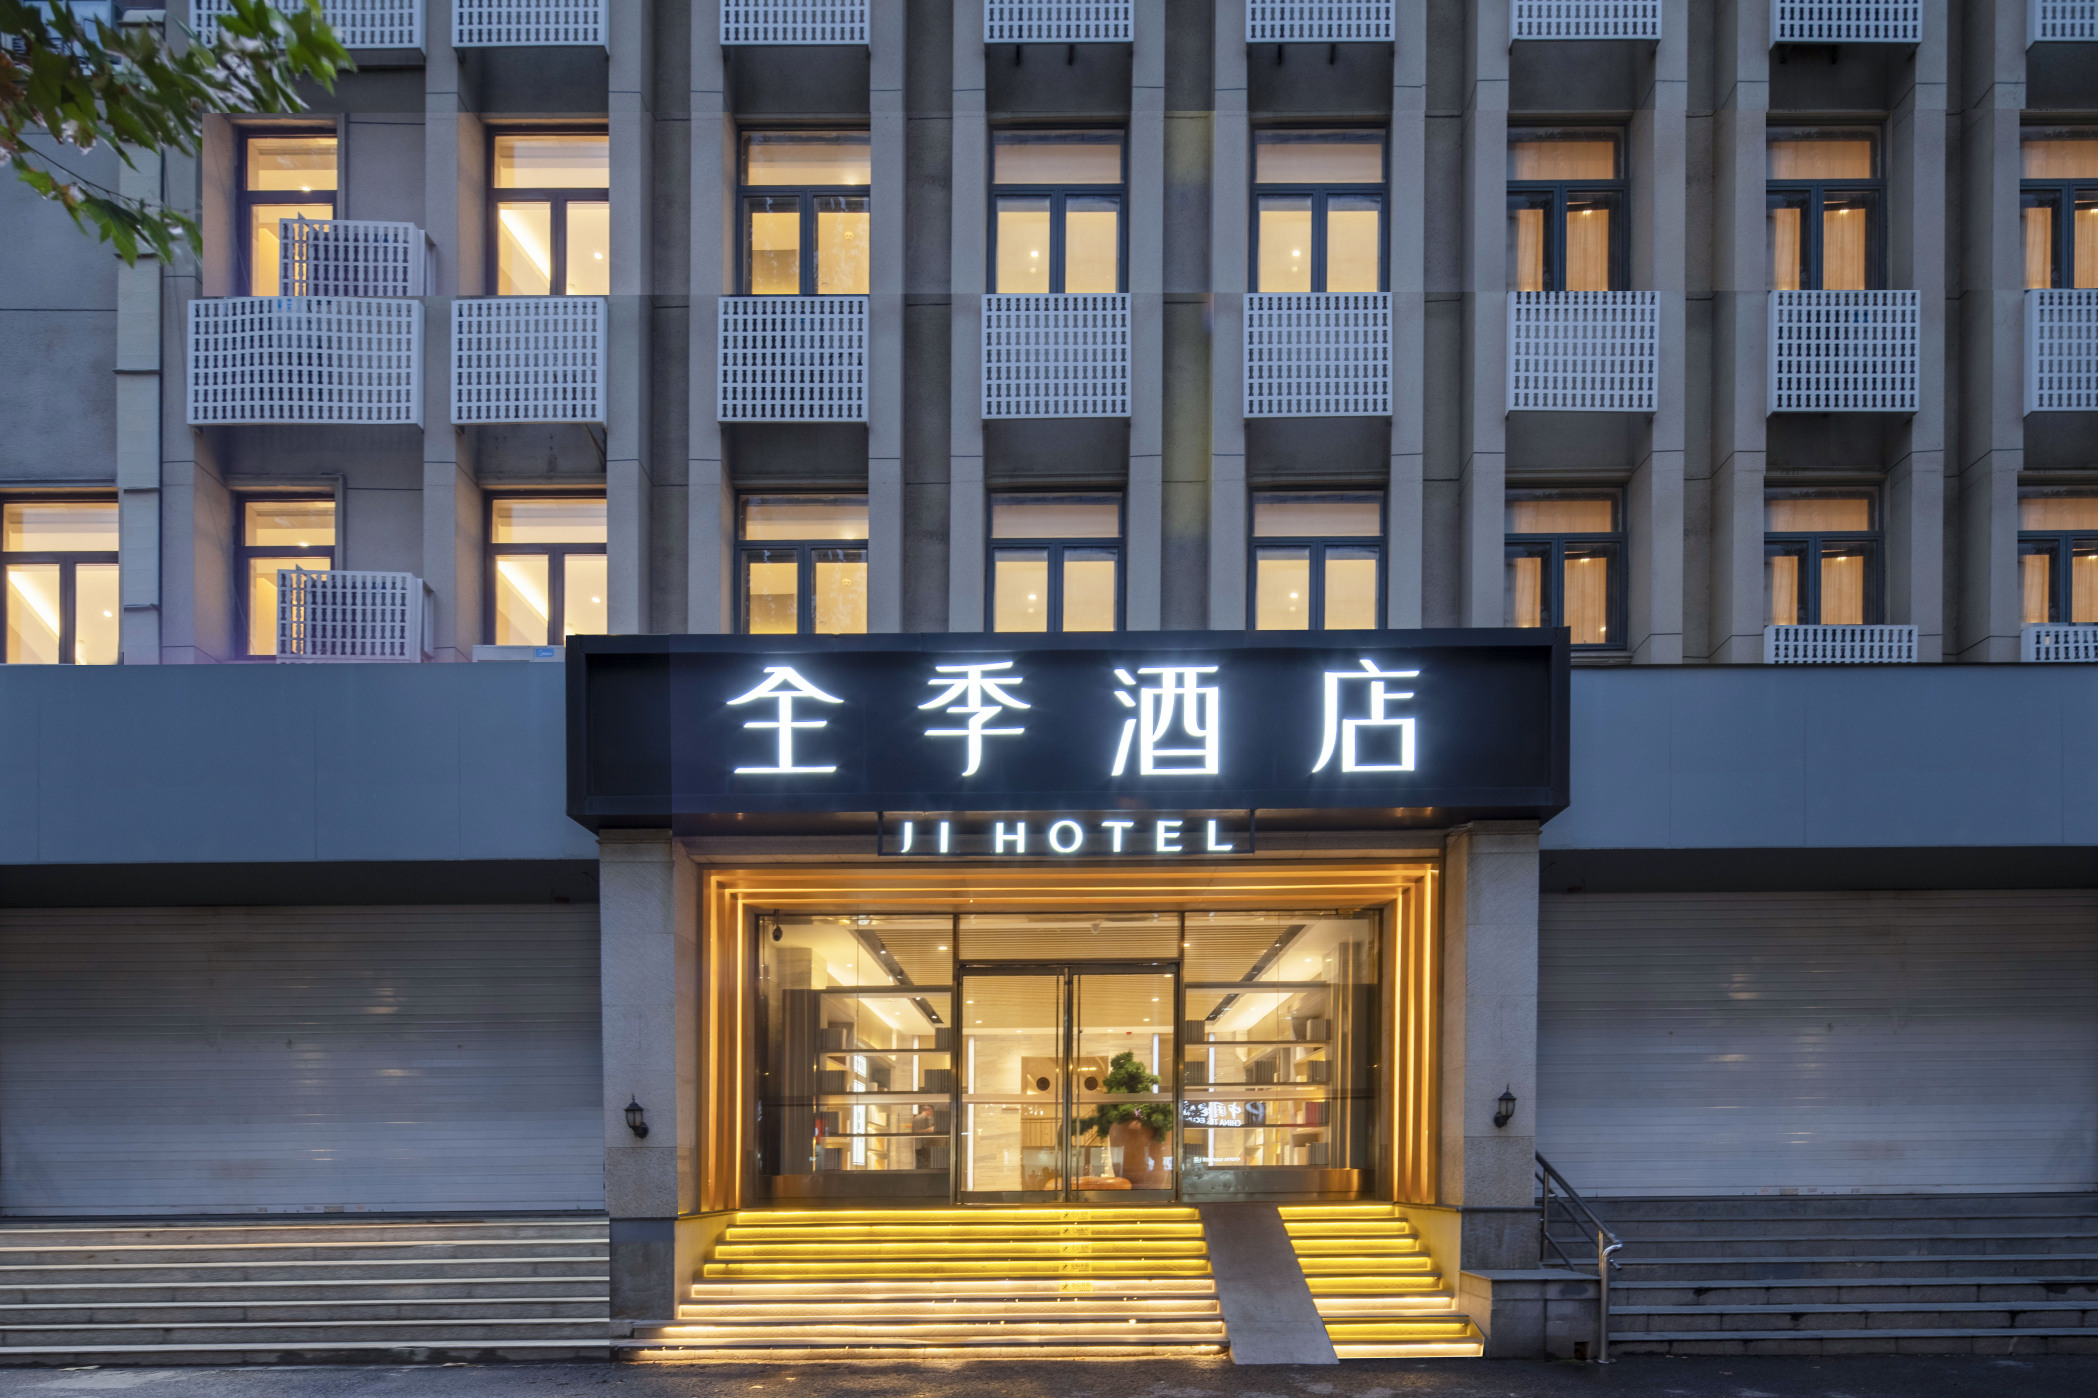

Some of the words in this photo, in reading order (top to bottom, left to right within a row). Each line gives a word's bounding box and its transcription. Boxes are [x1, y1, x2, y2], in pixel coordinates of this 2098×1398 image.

[725, 657, 1421, 777] 全季酒店
[899, 819, 949, 853] JI
[994, 819, 1233, 853] HOTEL
